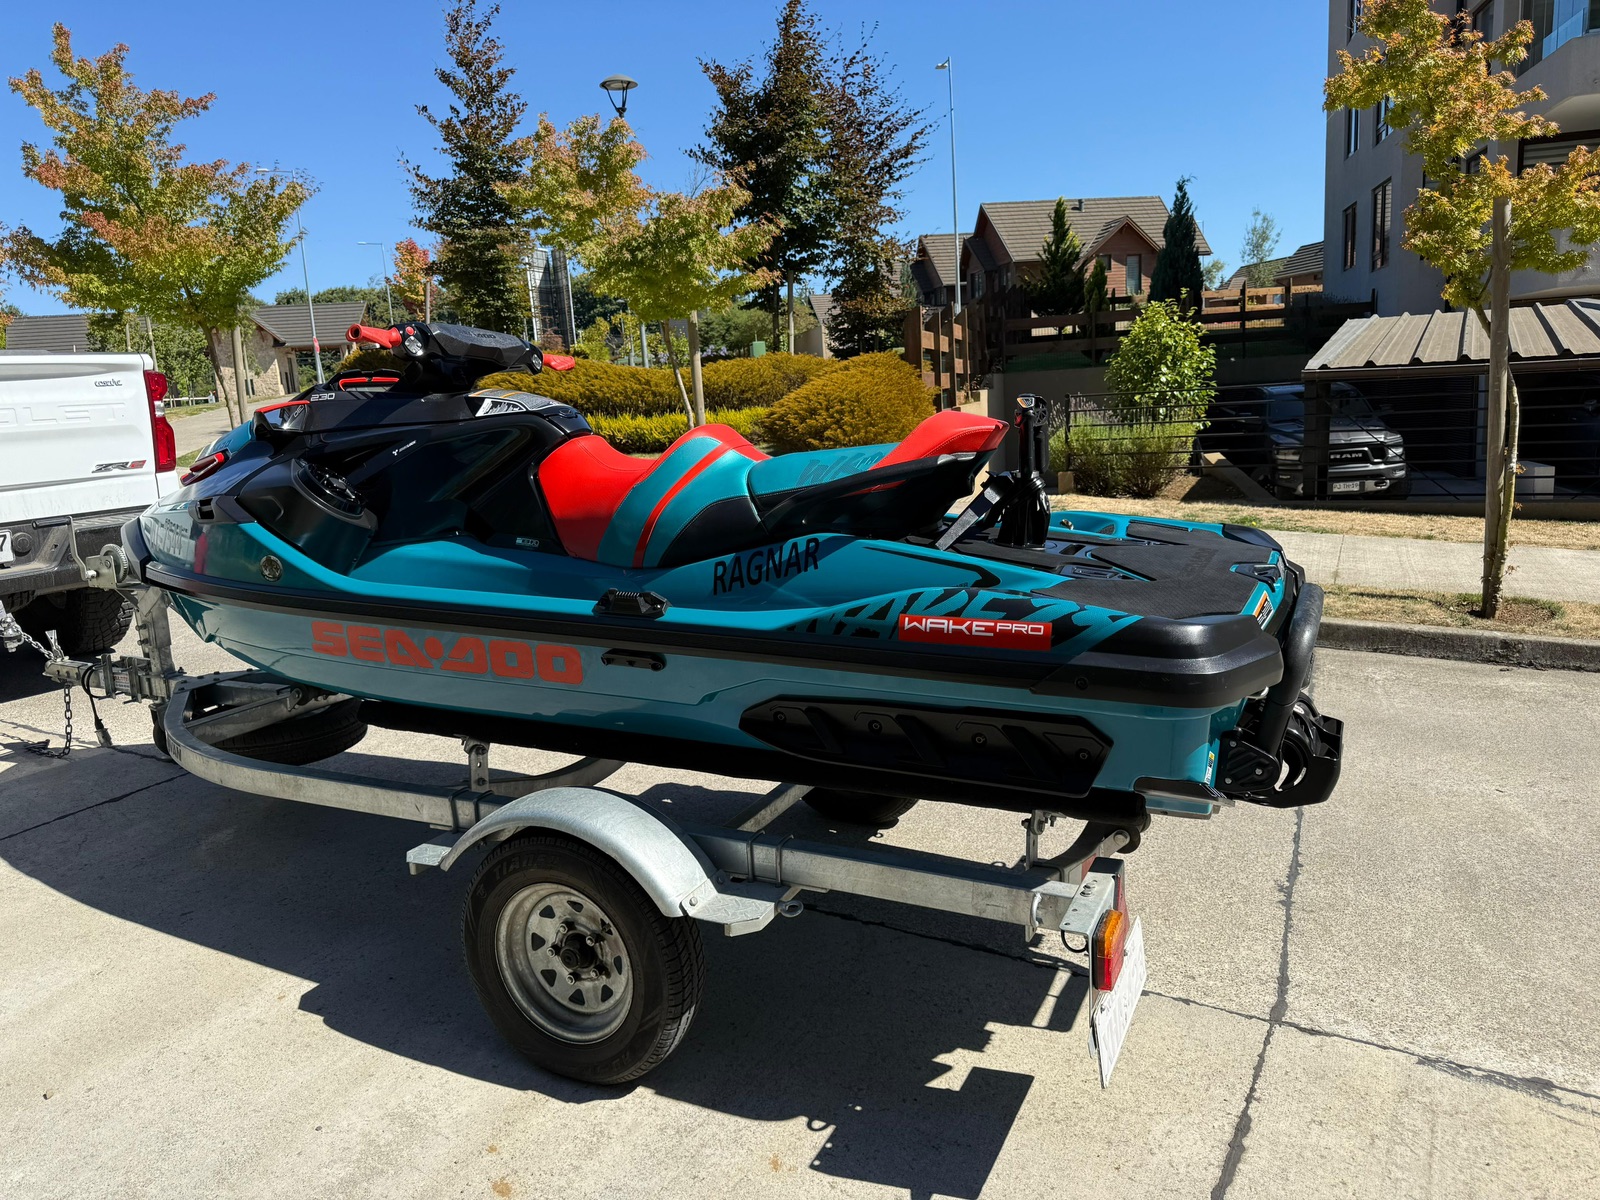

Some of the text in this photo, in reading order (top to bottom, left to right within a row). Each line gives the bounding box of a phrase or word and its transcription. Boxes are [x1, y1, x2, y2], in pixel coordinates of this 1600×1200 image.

[310, 392, 336, 402] 230
[1329, 452, 1363, 460] RAM
[712, 537, 820, 595] RAGNAR
[903, 616, 1044, 637] WAKE PRO
